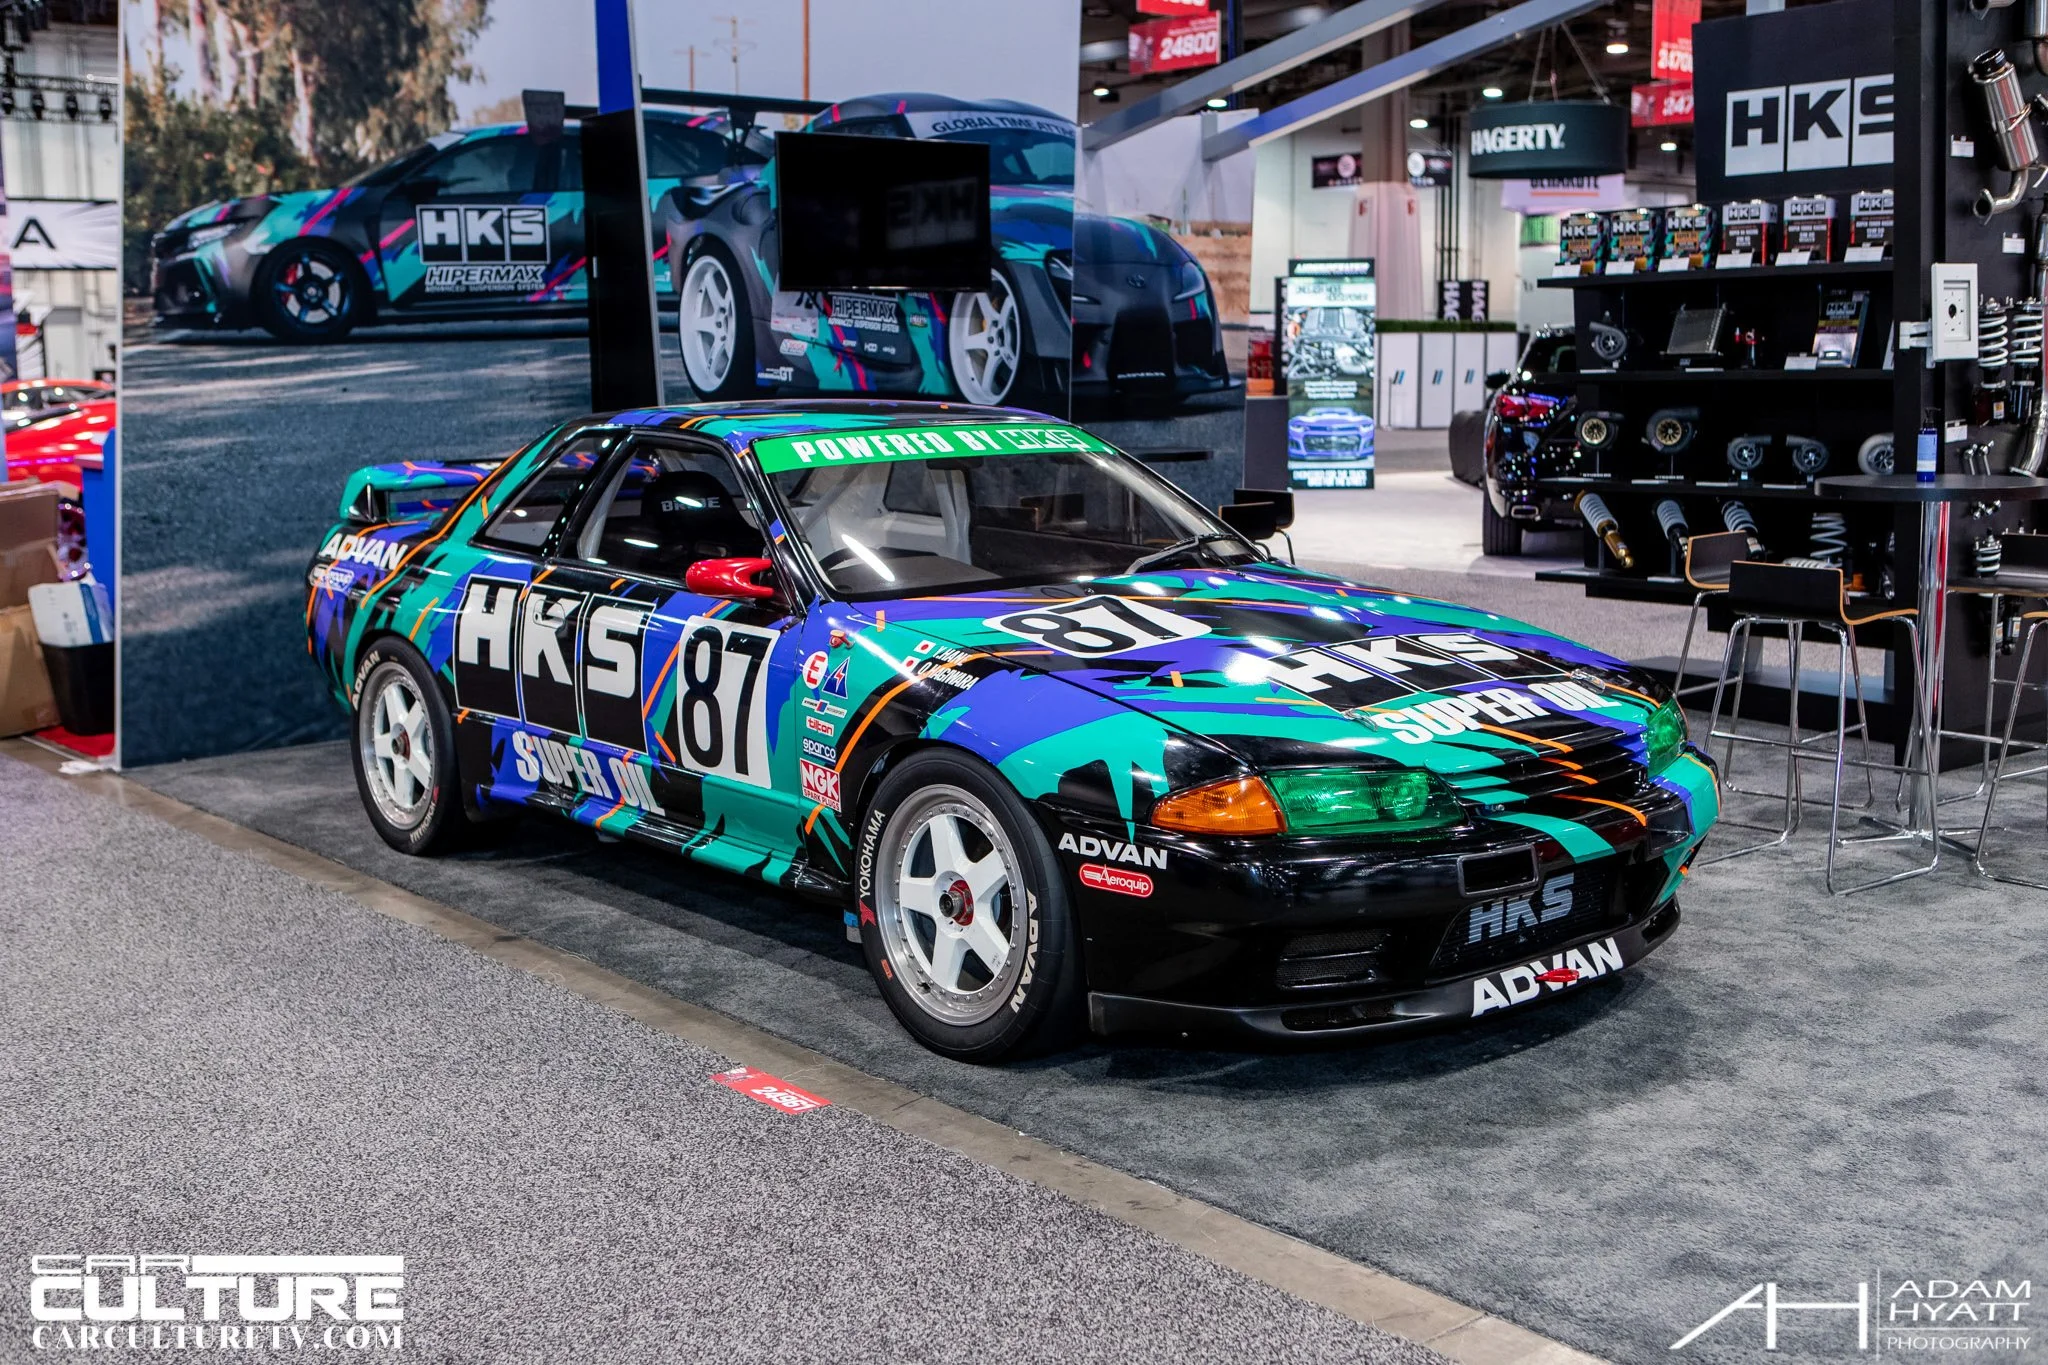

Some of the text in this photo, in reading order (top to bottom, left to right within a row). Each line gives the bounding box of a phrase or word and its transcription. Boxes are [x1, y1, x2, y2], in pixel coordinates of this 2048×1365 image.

[932, 116, 999, 133] GLOBAL
[996, 116, 1034, 128] TIME
[1732, 82, 1894, 148] HKS
[1471, 123, 1566, 156] HAGERTY
[1729, 207, 1760, 219] HKS
[1791, 202, 1826, 214] HKS
[1859, 197, 1894, 210] HKS
[421, 210, 545, 245] HKS
[1562, 225, 1598, 238] HKS
[1612, 220, 1650, 234] HKS
[1667, 216, 1707, 230] HKS
[425, 265, 546, 285] HIPERMAX
[830, 296, 897, 323] HIPERMAX
[792, 429, 1092, 463] POWERED BY HKS
[319, 532, 409, 571] ADVAN
[458, 583, 652, 699] HKS
[999, 595, 1183, 655] 87
[351, 650, 381, 712] ADVAN
[1266, 633, 1520, 694] HKS
[681, 626, 771, 776] 87
[1376, 679, 1622, 745] SUPER OIL
[808, 717, 832, 735] tilton
[803, 738, 836, 758] sparco
[511, 730, 666, 817] SUPER OIL
[800, 762, 839, 800] NGK
[803, 788, 840, 811] SPARK PLUGS
[859, 808, 886, 899] YOKOHAMA
[1058, 832, 1168, 870] ADVAN
[1099, 864, 1149, 893] Aeroquip
[1468, 872, 1574, 944] HKS
[1010, 887, 1039, 1014] ADVAN
[1471, 936, 1624, 1018] ADVAN
